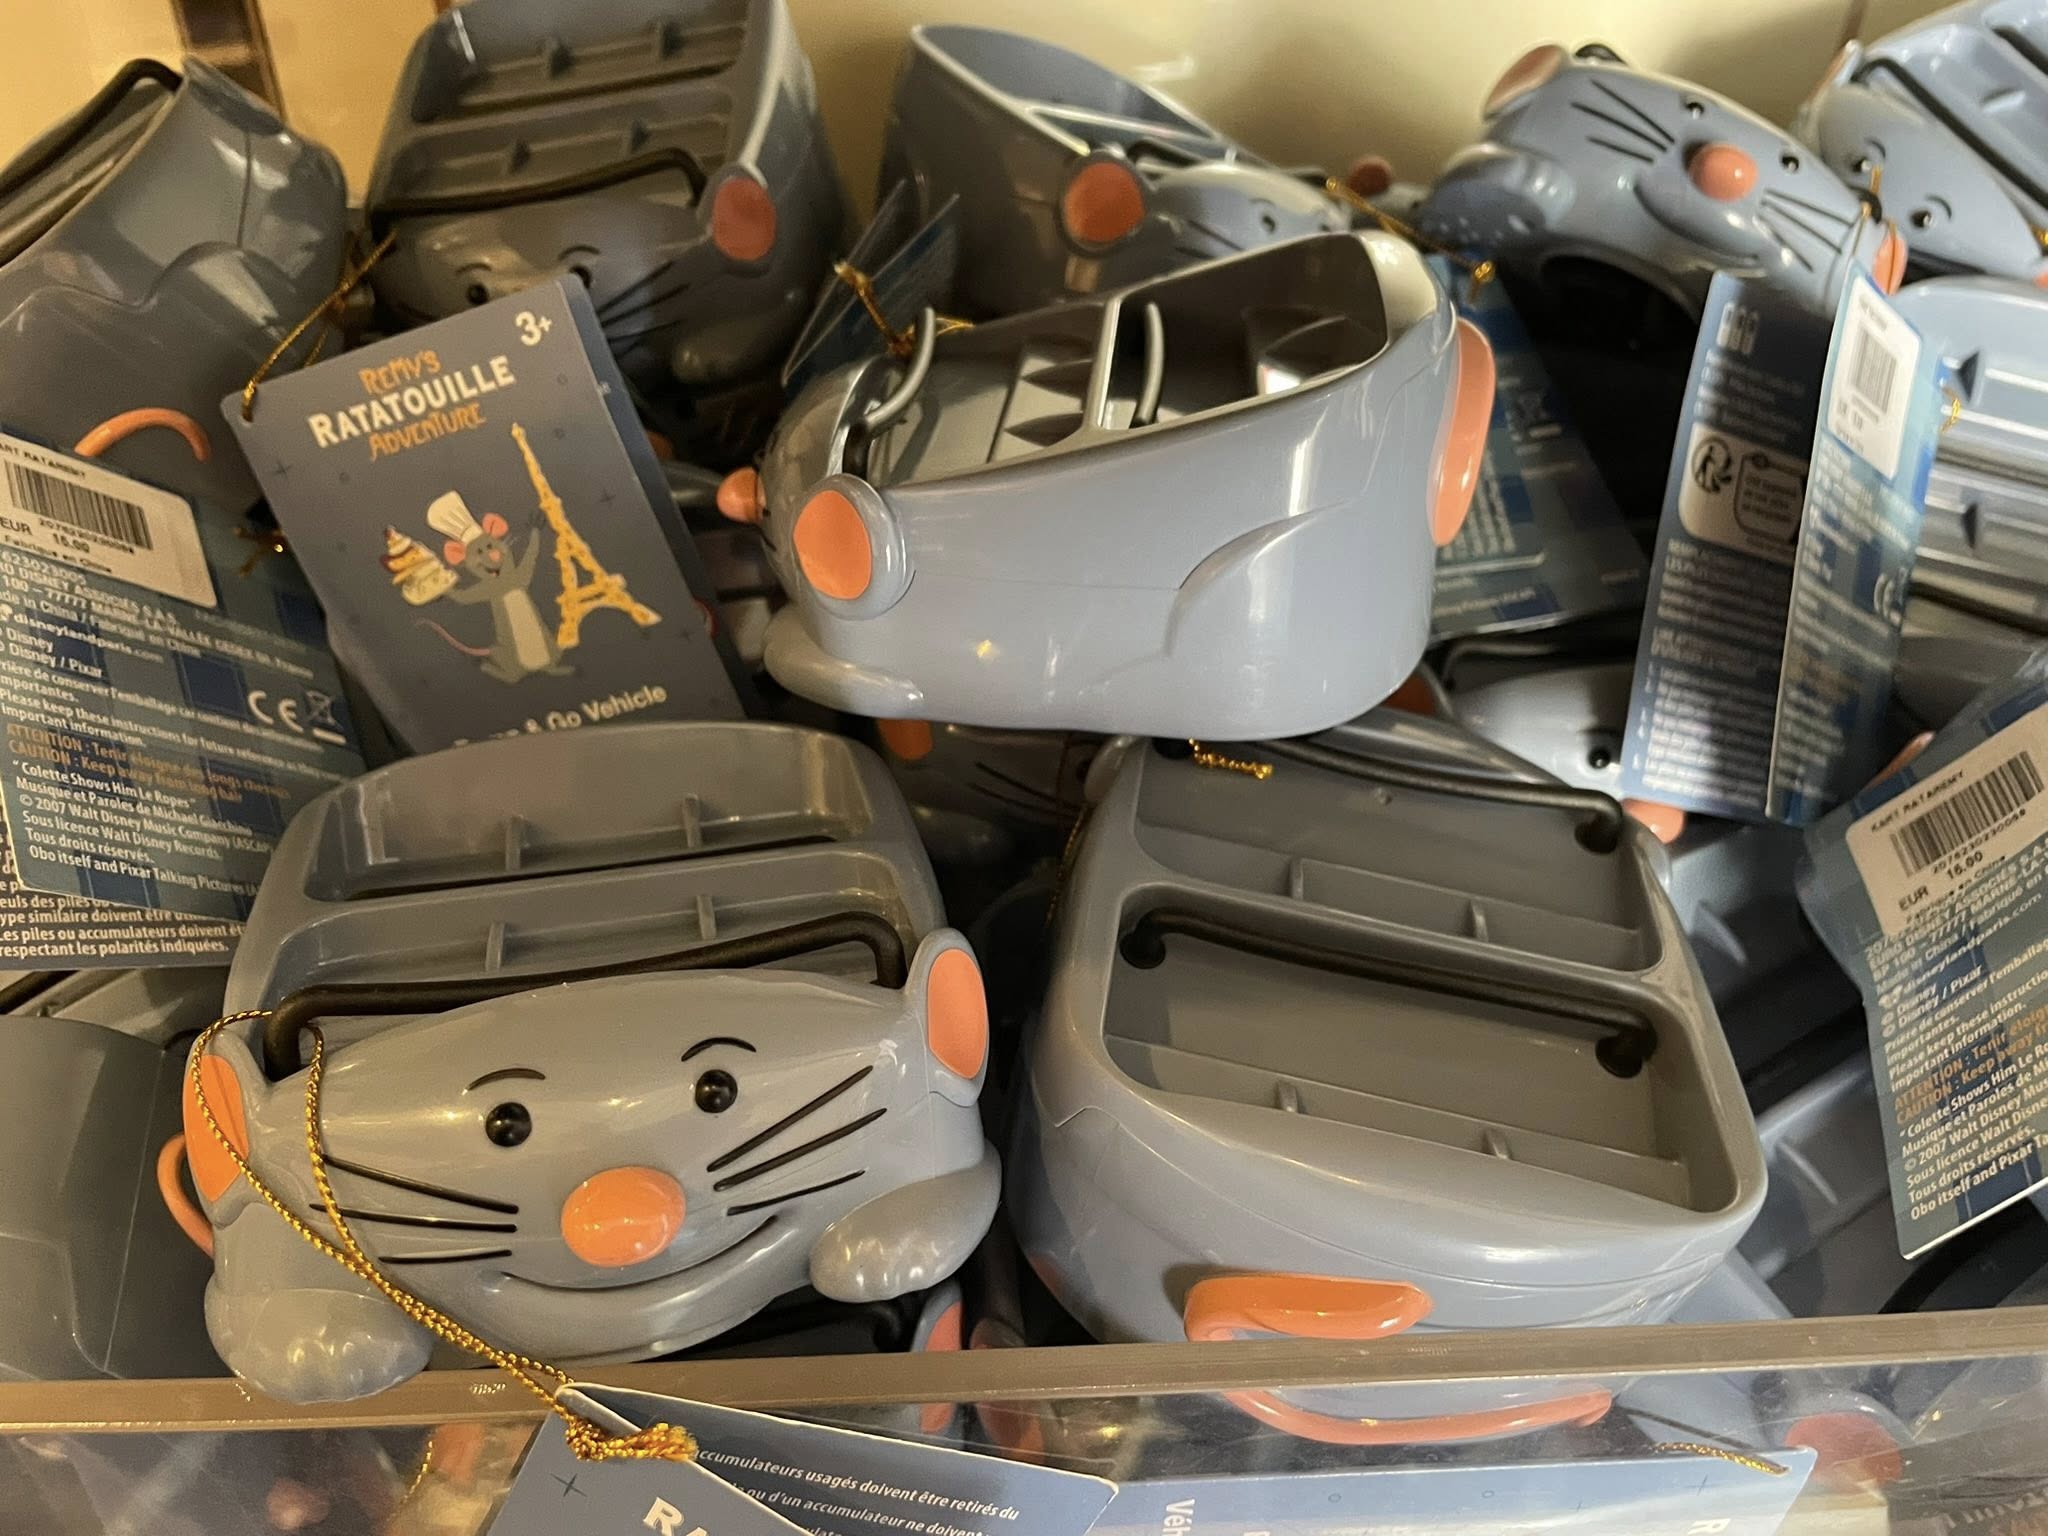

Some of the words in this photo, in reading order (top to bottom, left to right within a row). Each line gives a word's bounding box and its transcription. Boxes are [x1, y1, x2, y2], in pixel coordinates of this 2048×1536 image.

[514, 311, 552, 347] 3+
[0, 517, 33, 536] EUR
[6, 627, 54, 653] Disney
[9, 643, 56, 668] Disney
[69, 658, 103, 679] Pixar
[34, 669, 49, 681] de
[0, 688, 41, 708] Please
[42, 699, 74, 718] keep
[75, 707, 109, 726] these
[582, 685, 667, 721] Vehicle
[7, 722, 82, 752] ATTENTION
[9, 739, 72, 767] CAUTION
[81, 756, 115, 779] Keep
[16, 776, 72, 801] Musique
[73, 789, 87, 803] et
[88, 792, 134, 812] Paroles
[135, 801, 151, 815] de
[153, 805, 198, 825] Michael
[21, 762, 69, 784] Colette
[70, 773, 111, 792] Shows
[111, 782, 137, 798] Him
[138, 787, 153, 802] Le
[22, 810, 54, 827] Sous
[55, 817, 99, 837] licence
[101, 825, 131, 843] Walt
[132, 832, 172, 854] Disney
[36, 798, 66, 815] 2007
[69, 803, 100, 821] Walt
[100, 811, 141, 832] Disney
[143, 819, 177, 838] Music
[178, 825, 229, 848] Company
[25, 827, 56, 846] Tous
[58, 833, 97, 854] droits
[99, 843, 155, 865] réservés.
[29, 845, 56, 862] Obo
[57, 850, 92, 869] itself
[93, 857, 118, 874] and
[119, 861, 151, 879] Pixar
[153, 867, 198, 890] Talking
[28, 909, 89, 923] similaire
[90, 909, 144, 923] doivent
[31, 895, 55, 909] des
[58, 896, 90, 912] piles
[1899, 885, 1929, 911] EUR
[22, 926, 55, 944] piles
[57, 928, 76, 940] ou
[78, 924, 177, 940] accumulateurs
[178, 923, 227, 937] doivent
[77, 942, 97, 955] les
[99, 941, 160, 958] polarités
[161, 938, 229, 955] indiquées.
[1950, 965, 1982, 994] Pixar
[1934, 978, 1988, 1021] conserver
[1889, 1051, 1926, 1080] Please
[1927, 1032, 1955, 1056] keep
[1956, 1010, 1989, 1035] these
[1951, 1003, 2027, 1054] information.
[1971, 1032, 2006, 1060] Tenir
[1961, 1057, 1995, 1085] Keep
[1907, 1106, 1951, 1137] Colette
[1951, 1080, 1991, 1111] Shows
[1991, 1063, 2017, 1086] Him
[2018, 1053, 2033, 1068] Le
[1902, 1121, 1953, 1159] Musique
[1954, 1111, 1968, 1126] et
[1968, 1082, 2016, 1117] Paroles
[2015, 1071, 2032, 1088] de
[1919, 1137, 1947, 1166] 2007
[1949, 1121, 1979, 1145] Walt
[1979, 1095, 2021, 1127] Disney
[1906, 1164, 1936, 1189] Sous
[1936, 1138, 1979, 1171] licence
[1979, 1118, 2011, 1143] Walt
[1908, 1181, 1937, 1203] Tous
[1939, 1158, 1976, 1187] droits
[1977, 1125, 2036, 1165] réservés.
[1910, 1199, 1937, 1220] Obo
[1937, 1174, 1971, 1206] itself
[1972, 1160, 1998, 1185] and
[1999, 1142, 2033, 1170] Pixar
[747, 1488, 766, 1500] ou
[768, 1491, 801, 1507] d'un
[803, 1500, 906, 1527] accumulateur
[905, 1520, 924, 1533] ne
[805, 1470, 858, 1489] usagés
[860, 1480, 920, 1500] doivent
[918, 1490, 949, 1507] être
[950, 1498, 998, 1516] retirés
[999, 1506, 1020, 1520] du
